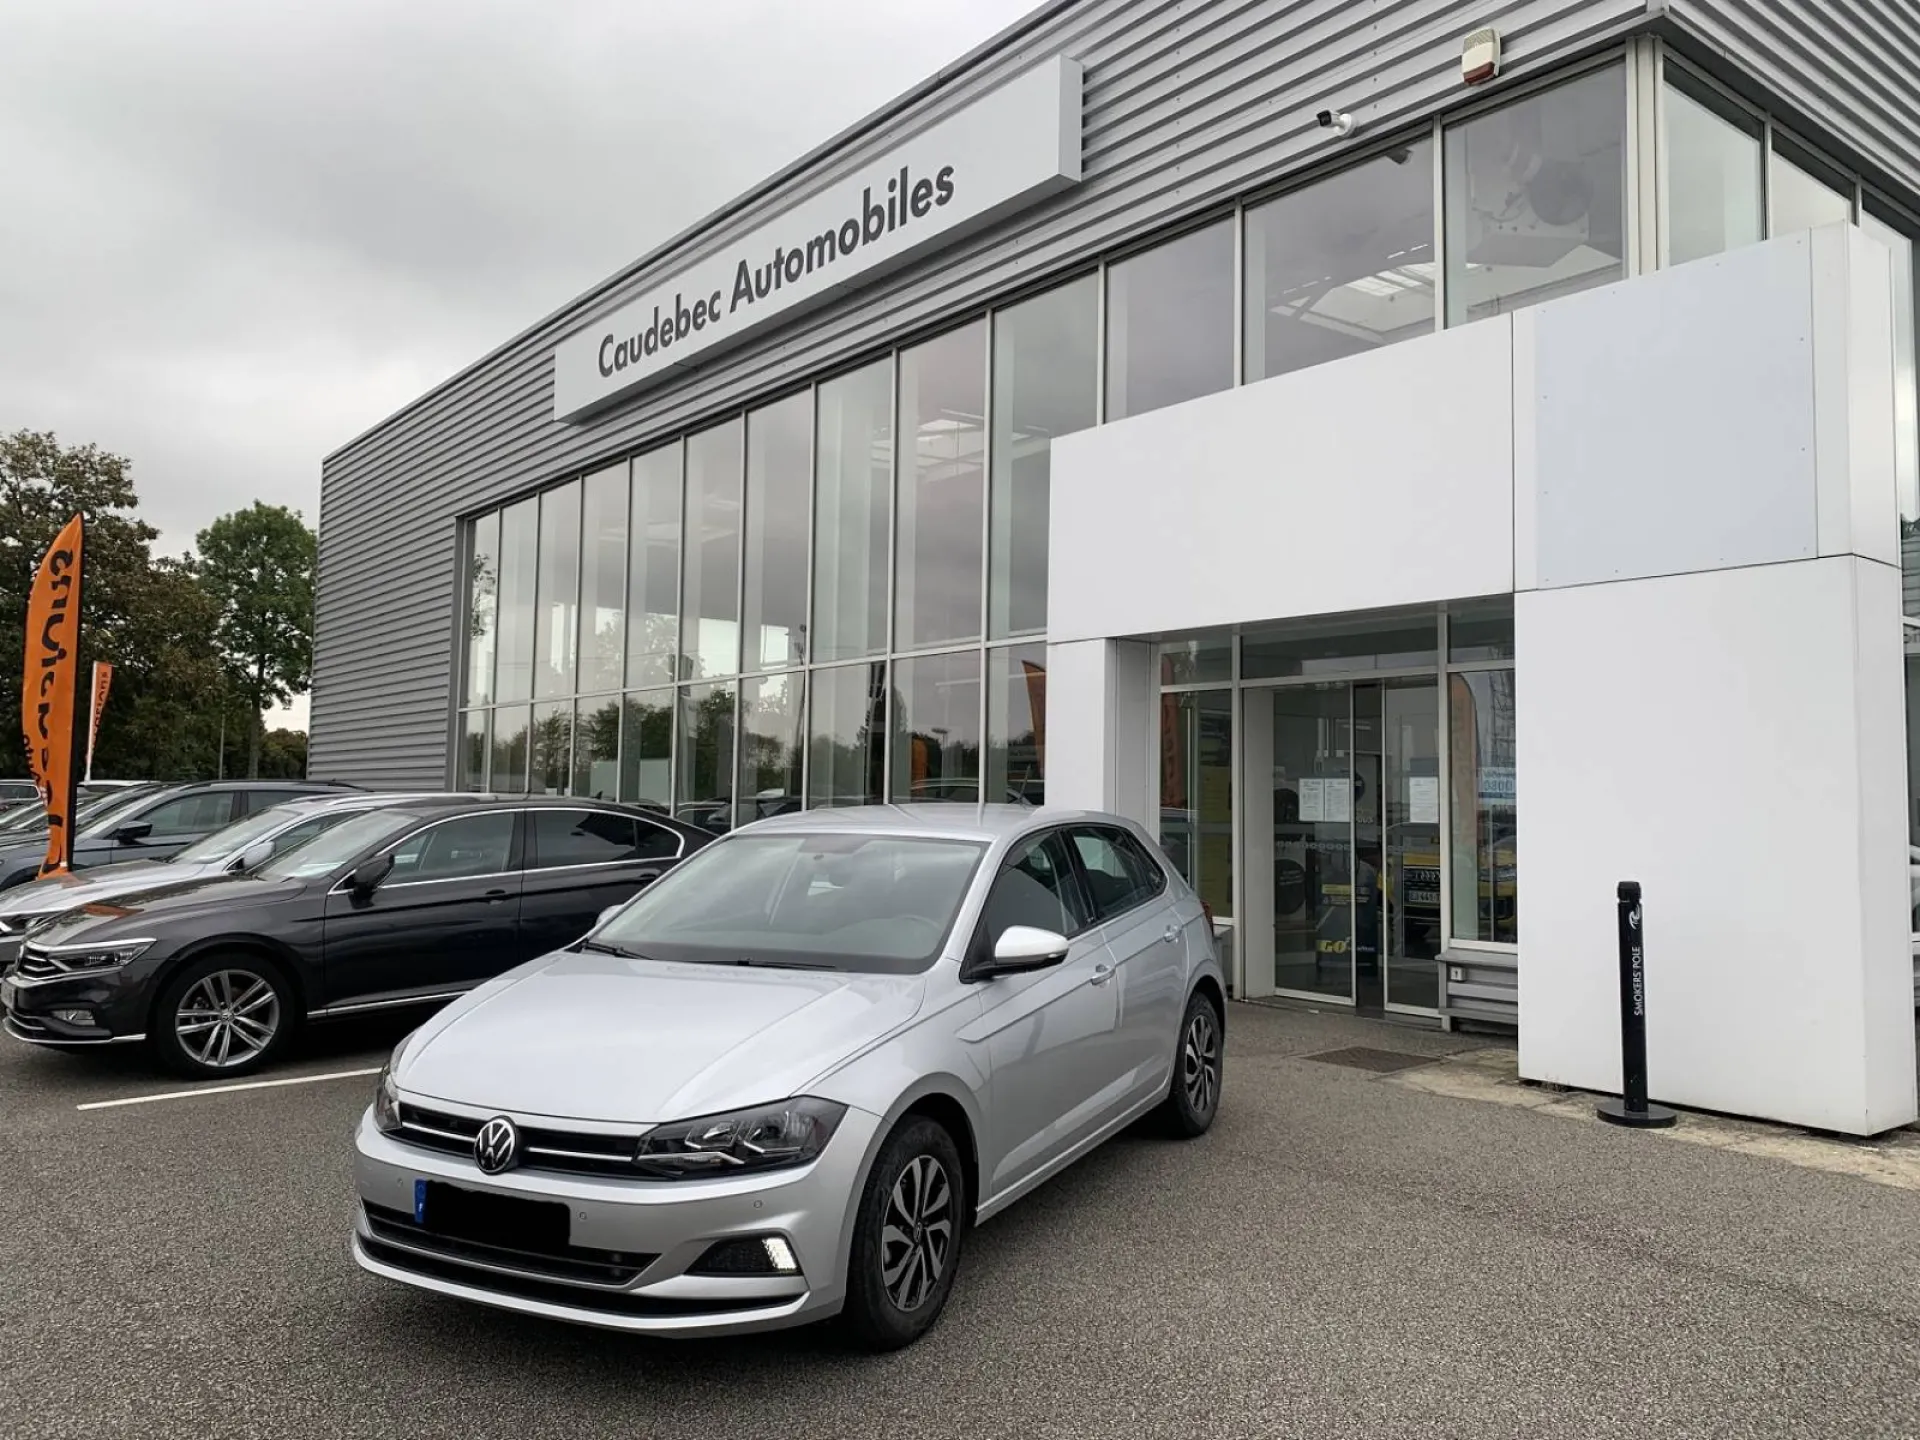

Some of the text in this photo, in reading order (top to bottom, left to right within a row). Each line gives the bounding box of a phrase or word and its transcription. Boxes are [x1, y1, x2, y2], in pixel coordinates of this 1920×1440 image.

[599, 165, 954, 378] Caudebec Automobiles
[1632, 945, 1641, 969] POLE
